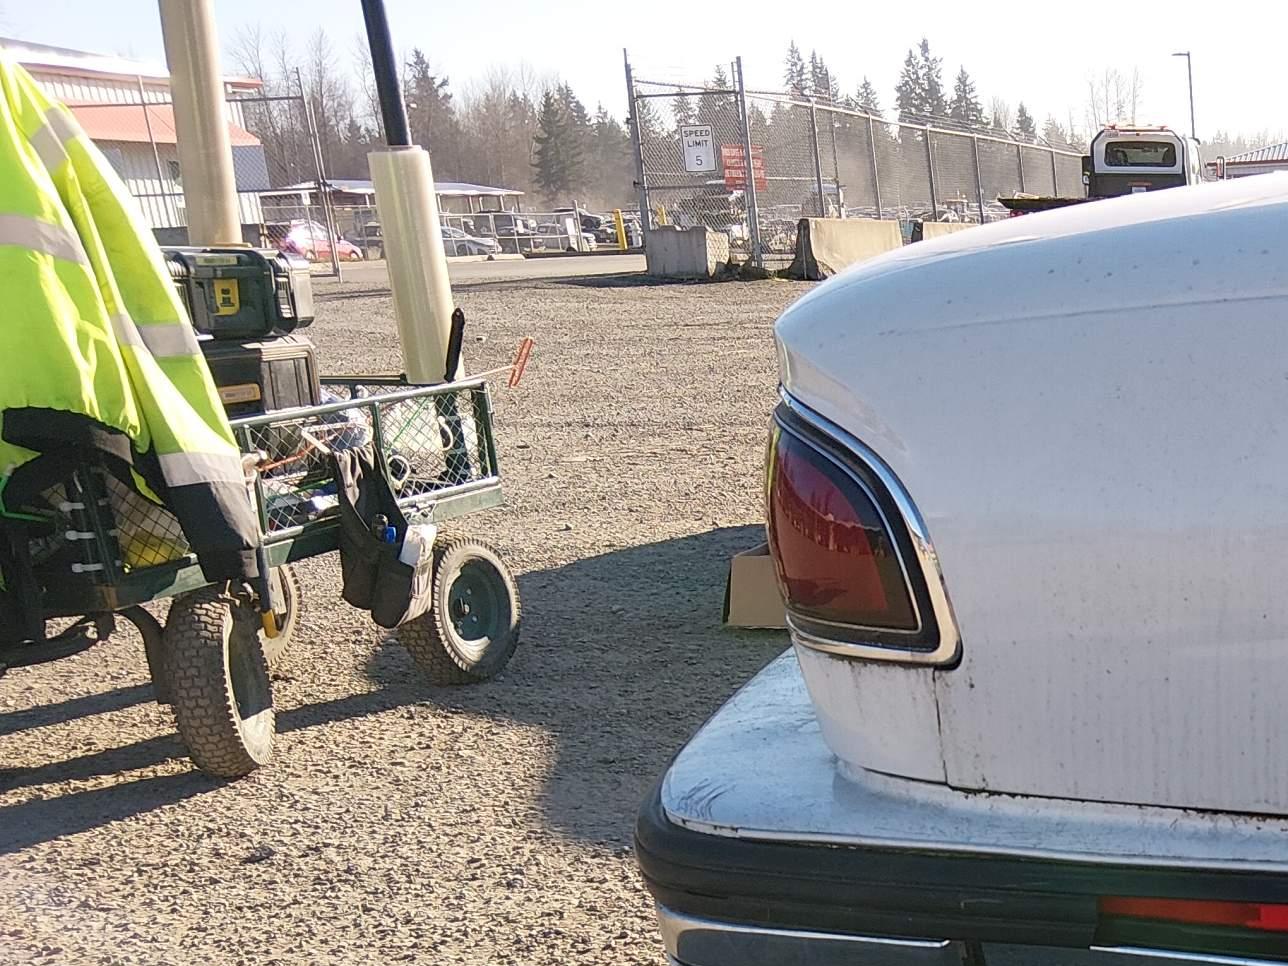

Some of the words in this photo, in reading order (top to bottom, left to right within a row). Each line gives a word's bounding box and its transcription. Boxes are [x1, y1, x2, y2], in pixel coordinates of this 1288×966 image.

[683, 129, 710, 137] SPEED
[687, 139, 708, 148] LIMIT
[695, 155, 703, 166] 5
